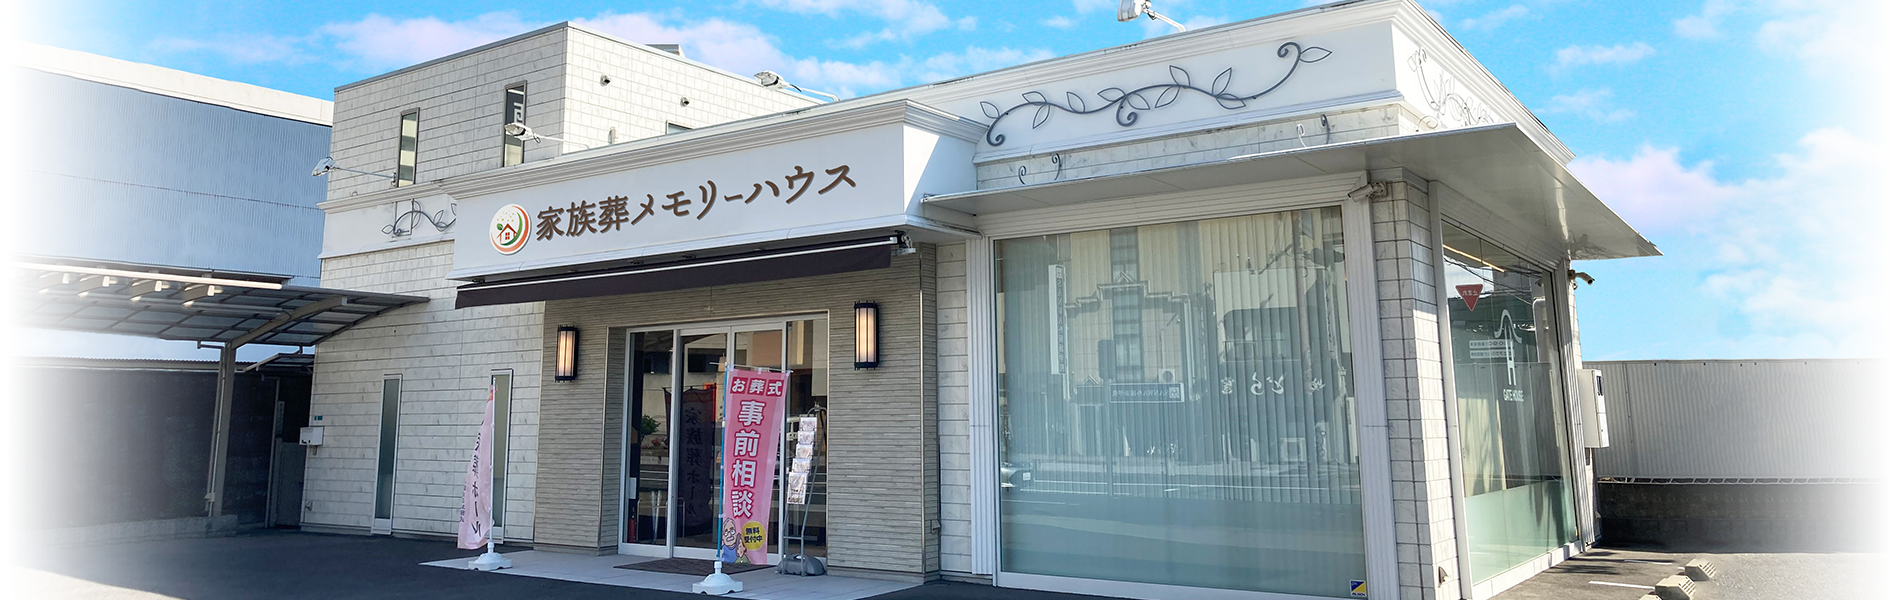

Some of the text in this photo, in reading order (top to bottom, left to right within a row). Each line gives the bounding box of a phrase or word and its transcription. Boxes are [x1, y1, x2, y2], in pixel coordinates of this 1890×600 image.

[536, 165, 857, 241] 家族葬メモリーハウス
[731, 378, 783, 396] お葬式
[731, 400, 766, 518] 事前相談
